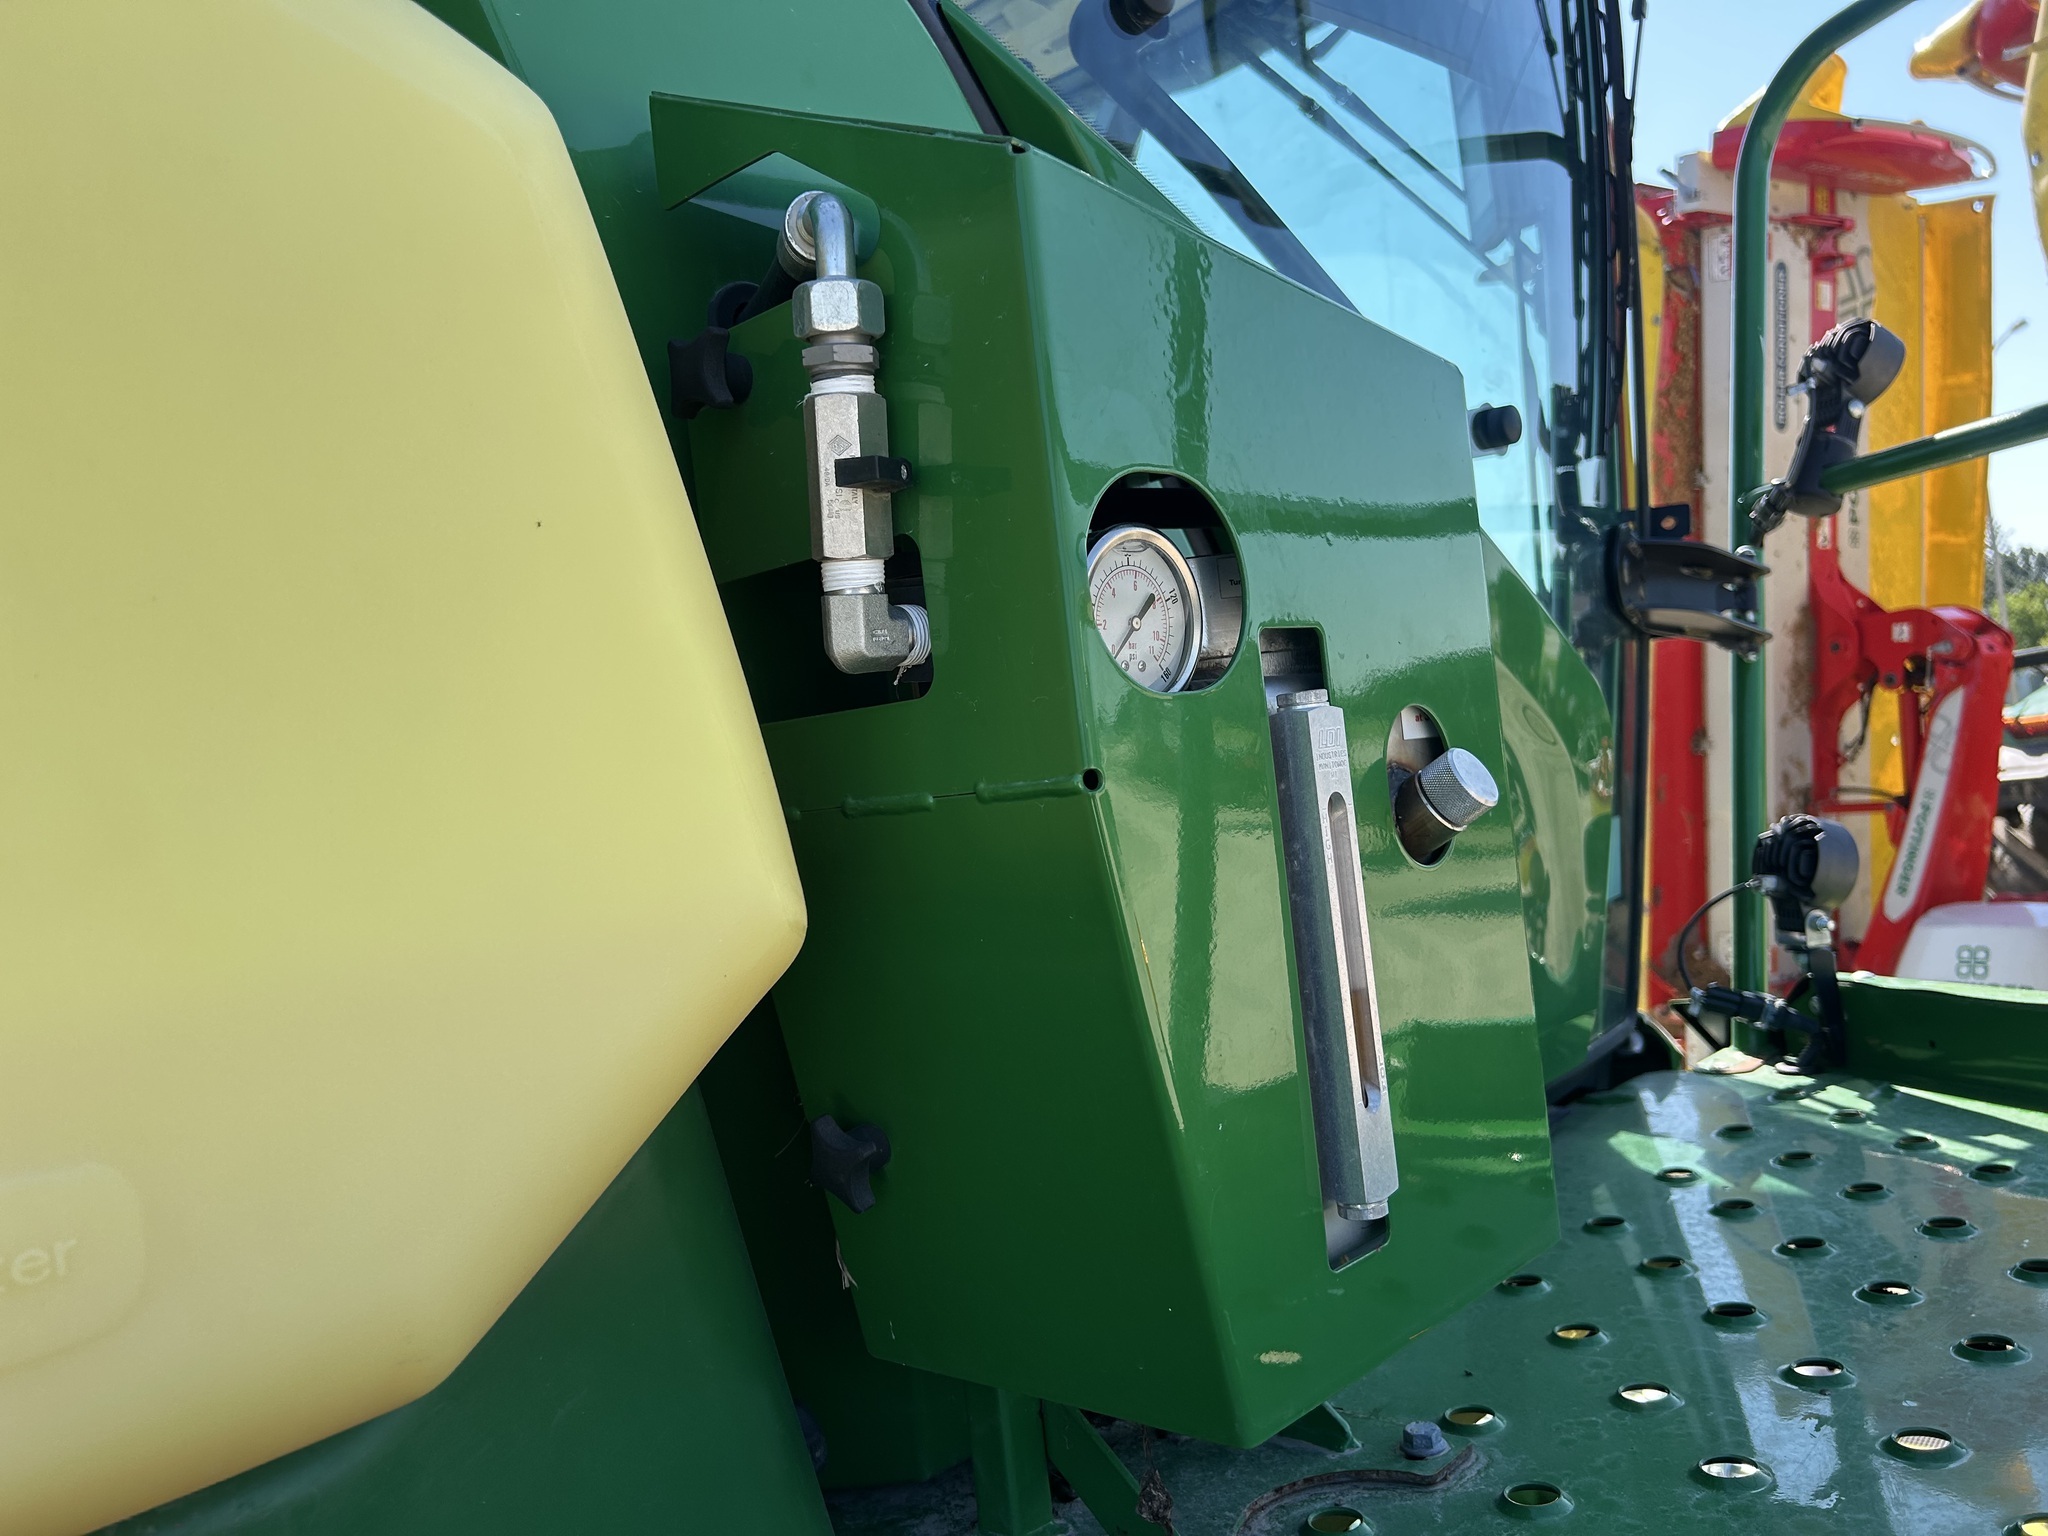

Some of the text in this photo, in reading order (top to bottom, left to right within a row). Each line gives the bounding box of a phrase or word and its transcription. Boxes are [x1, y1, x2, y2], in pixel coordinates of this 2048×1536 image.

[1111, 587, 1117, 599] 4
[1133, 581, 1138, 593] 6
[1168, 588, 1179, 605] 120
[1102, 619, 1108, 631] 2
[1152, 630, 1160, 641] 10
[1128, 641, 1138, 650] bar
[1148, 645, 1155, 655] 11
[1128, 652, 1138, 662] psi
[1160, 667, 1172, 682] 160
[1414, 713, 1423, 722] at
[1318, 727, 1341, 749] LDI
[1315, 749, 1347, 762] INDUSTRIES
[1321, 814, 1334, 864] HIGH
[0, 1238, 78, 1292] er
